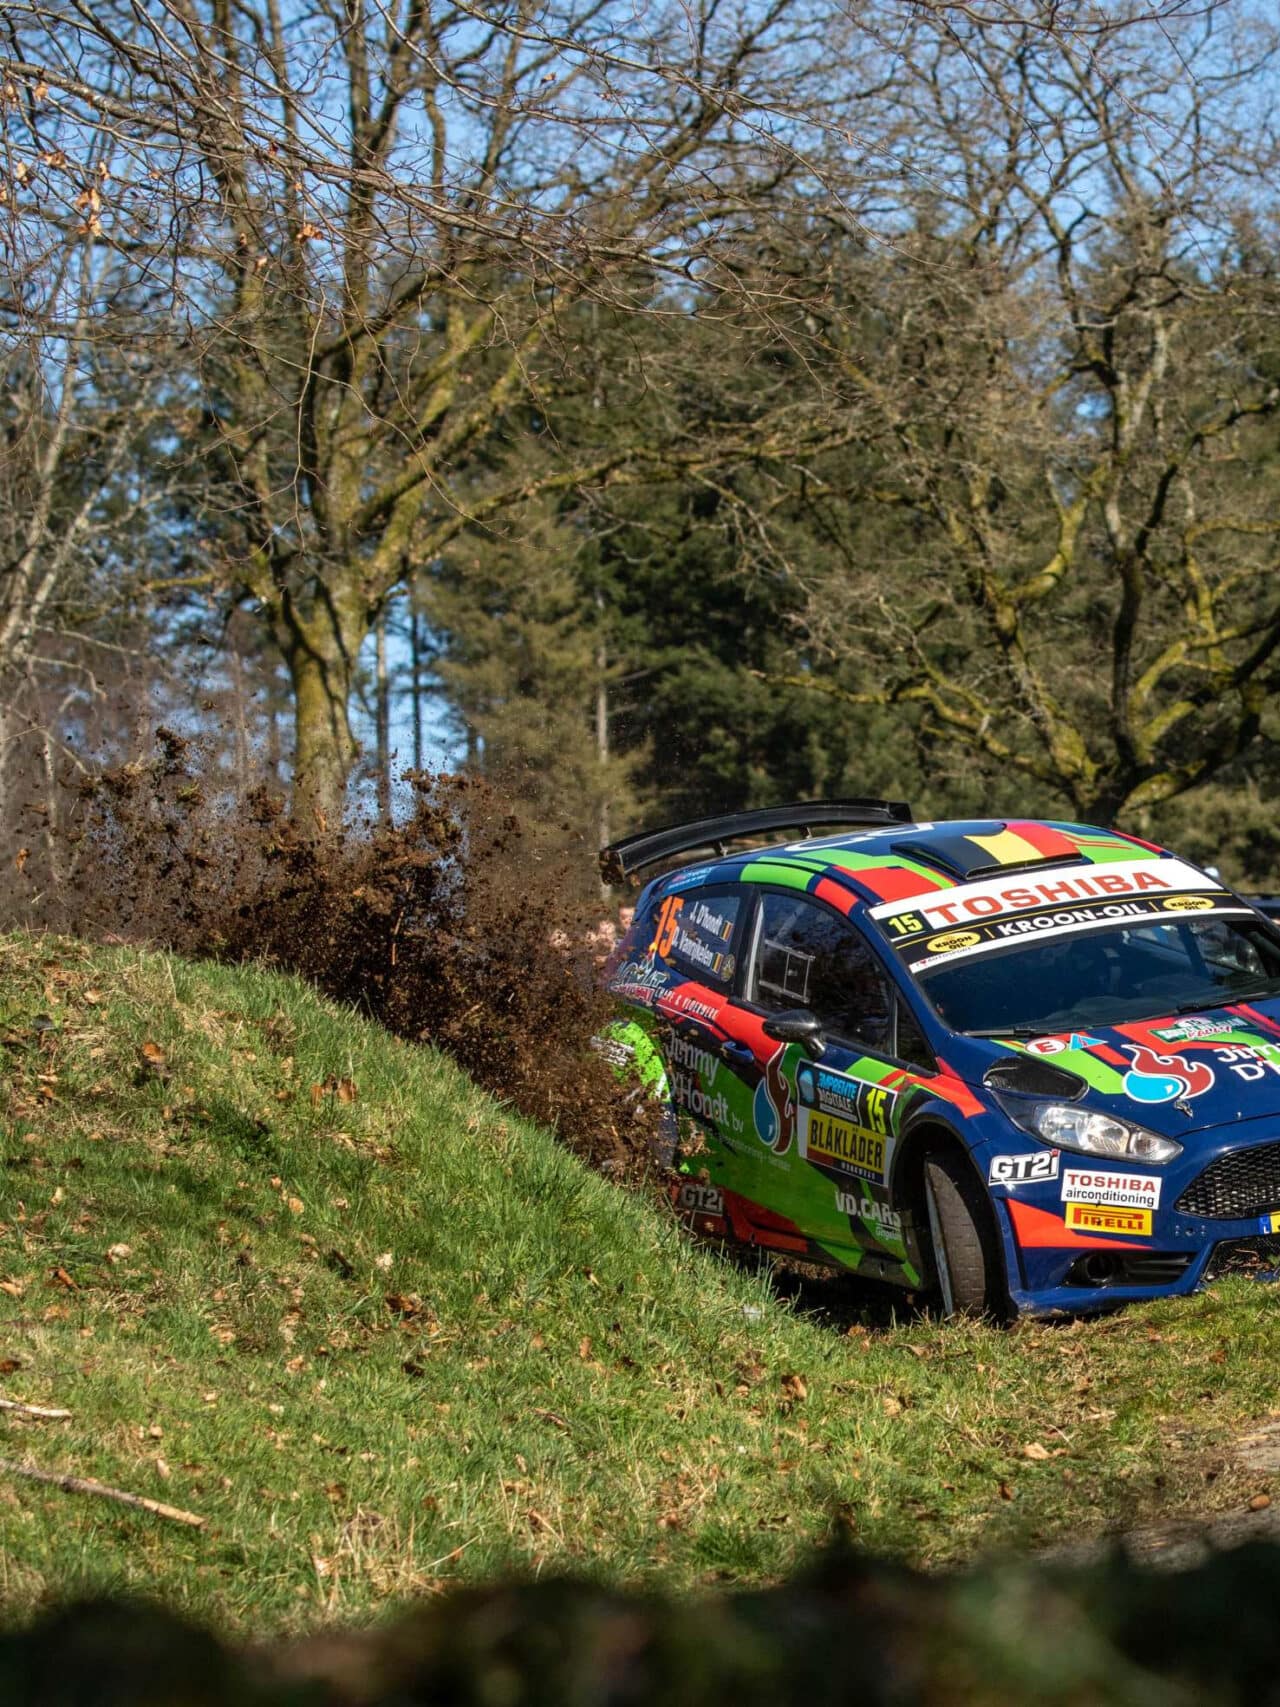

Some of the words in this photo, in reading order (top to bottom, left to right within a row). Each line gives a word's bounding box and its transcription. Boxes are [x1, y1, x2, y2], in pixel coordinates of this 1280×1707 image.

[923, 871, 1172, 924] TOSHIBA
[655, 895, 685, 958] 15
[888, 913, 923, 935] 15
[997, 902, 1148, 937] KROON-OIL
[934, 935, 973, 948] KROON
[948, 942, 967, 950] OIL
[1035, 1041, 1057, 1052] E
[866, 1087, 888, 1135] 15
[810, 1118, 883, 1169] BLÅKLÄDER
[991, 1148, 1059, 1180] GT2i
[1067, 1173, 1156, 1193] TOSHIBA
[1066, 1188, 1155, 1208] airconditioning
[1072, 1207, 1145, 1230] PIRELLI
